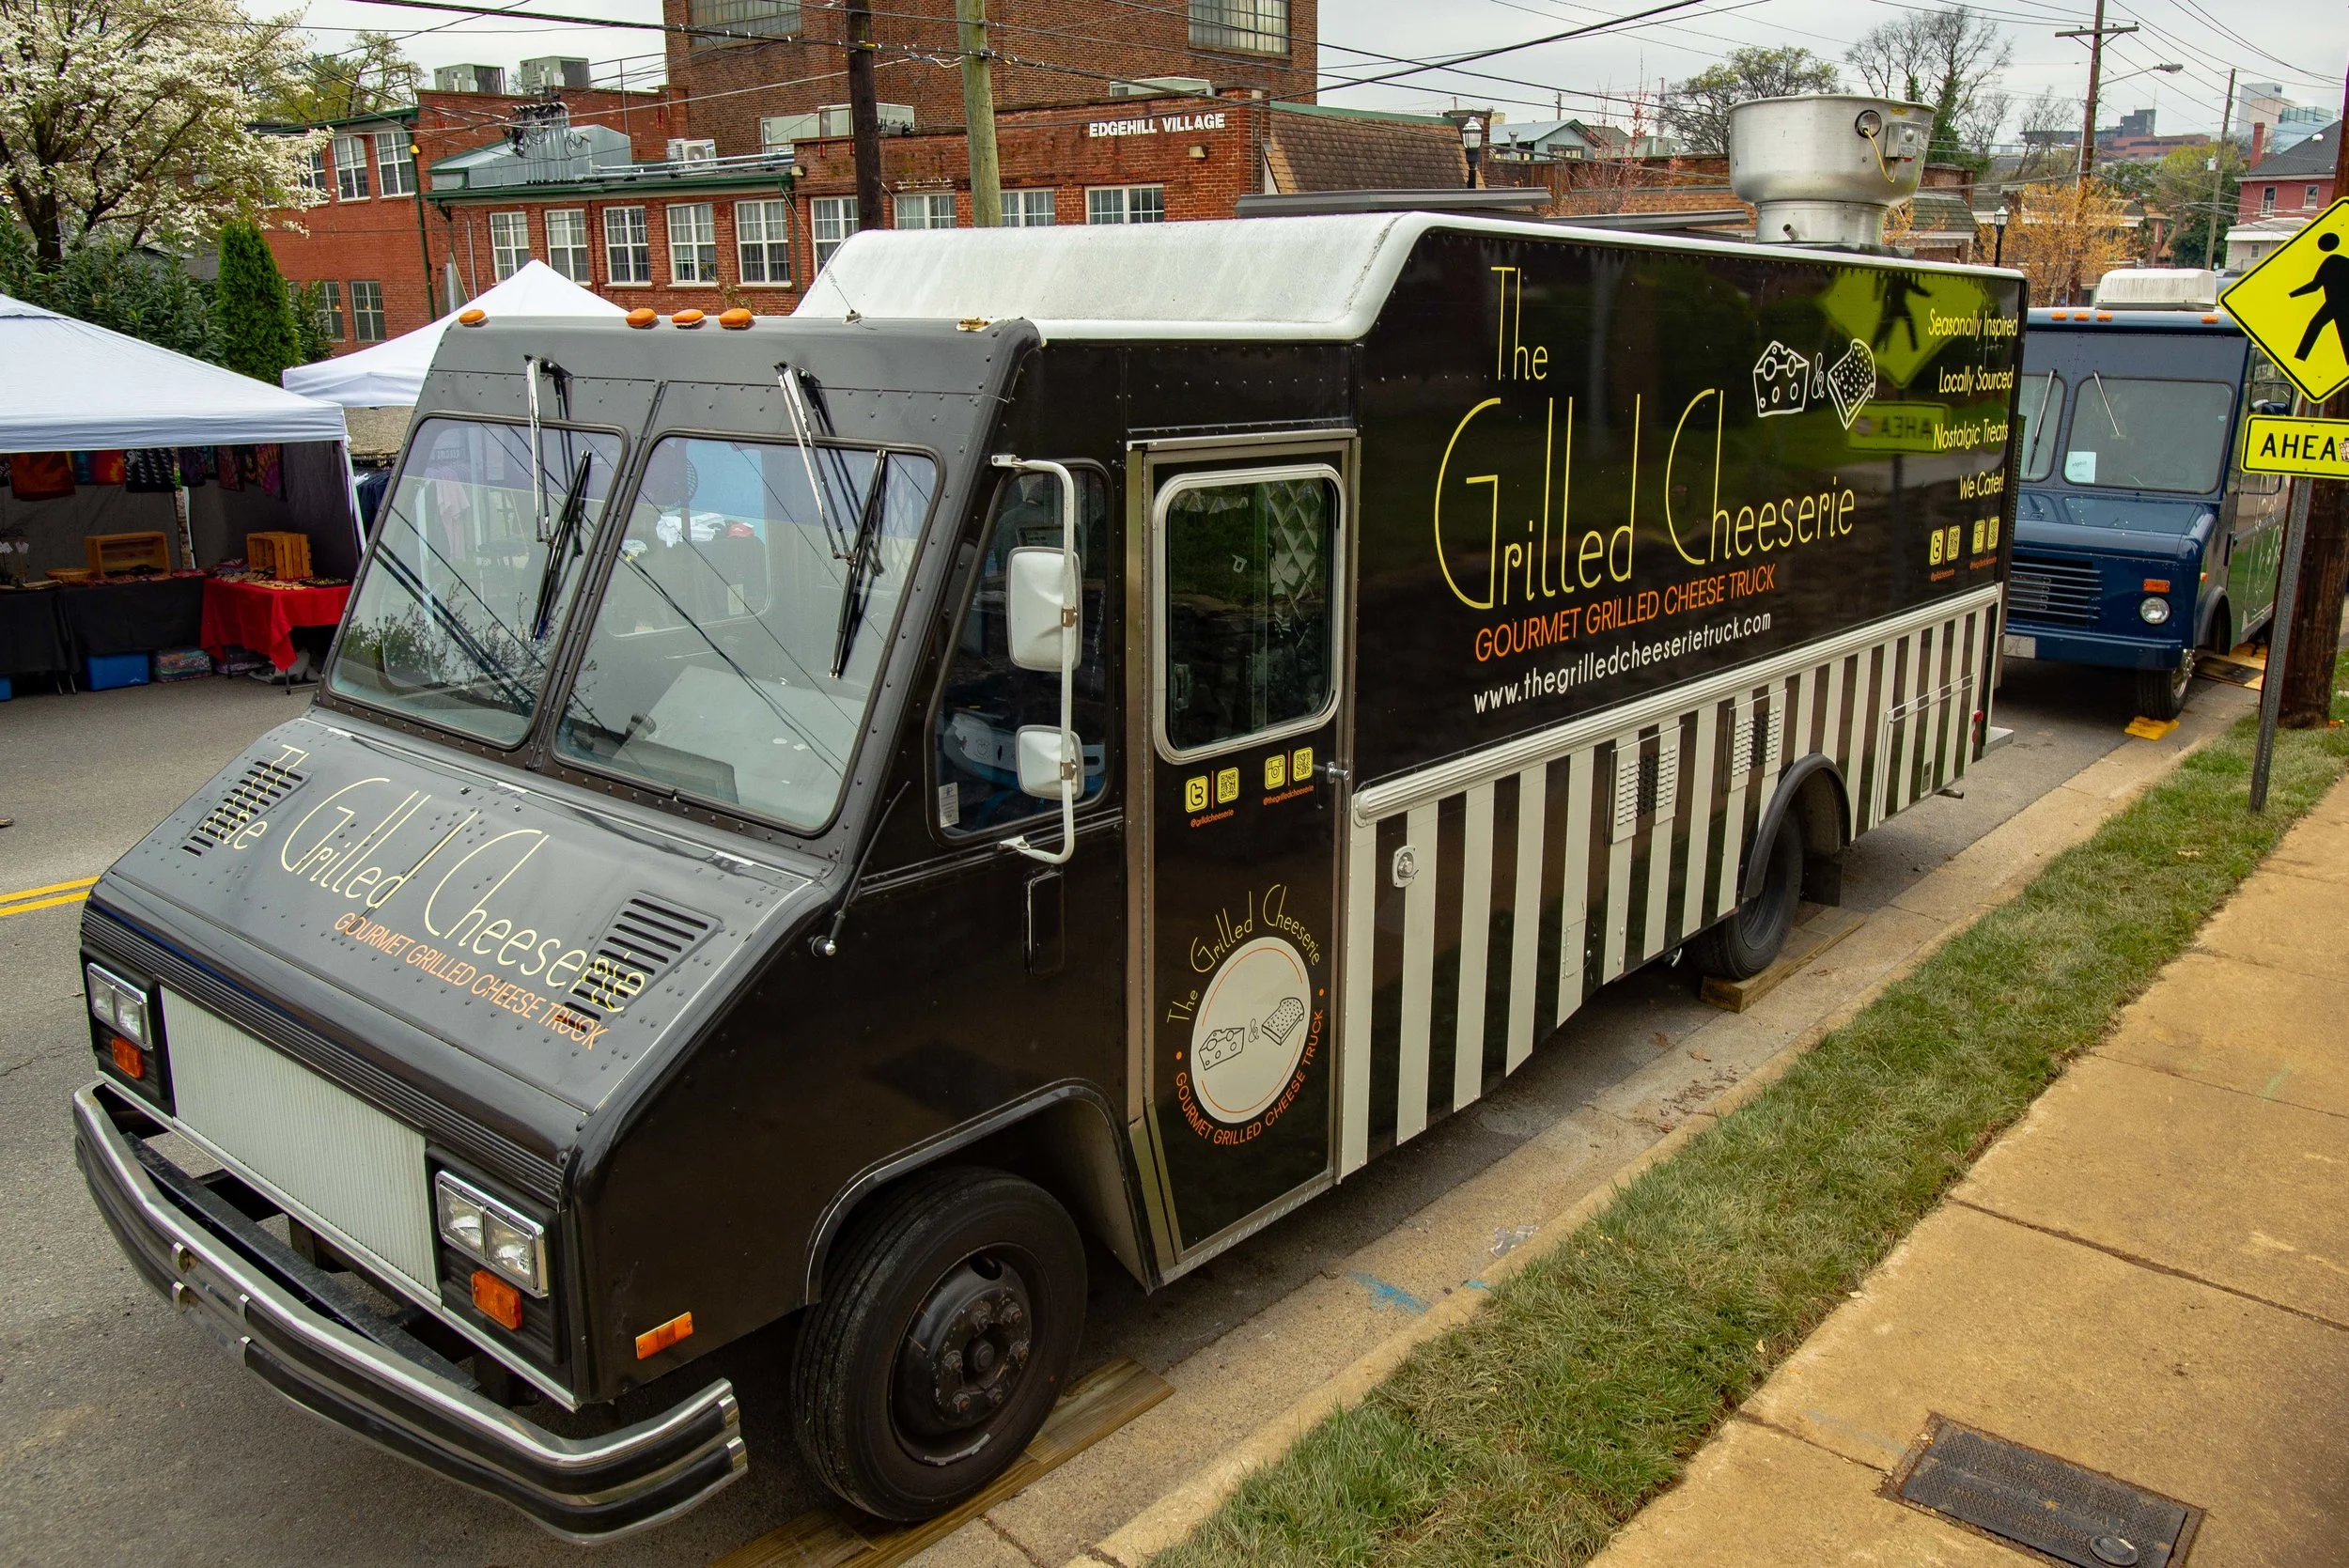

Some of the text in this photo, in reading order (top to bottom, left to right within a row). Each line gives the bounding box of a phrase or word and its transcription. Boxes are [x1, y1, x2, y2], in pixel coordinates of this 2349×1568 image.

[1089, 113, 1225, 138] EDGEHILL VILLAGE
[1490, 266, 1548, 380] The
[1928, 307, 2019, 341] Seasonally Inspired
[1938, 364, 2015, 396] Locally Sourced
[1933, 418, 2008, 450] Nostalgic Treats
[1960, 468, 2005, 500] We Cater!
[2260, 432, 2349, 461] AHEA
[1434, 387, 1856, 611] Grilled Cheeserie
[1475, 563, 1776, 662] GOURMET GRILLED CHEESE TRUCK
[1473, 613, 1772, 714] www.thegrilledcheeserietruck.com
[202, 743, 310, 849] The
[281, 776, 646, 1013] Grilled Cheeserie
[334, 912, 610, 1051] GOURMET GRILLED CHEESE TRUCK
[1166, 883, 1321, 1024] The Grilled Cheeserie
[1175, 1009, 1324, 1146] GOURMET GRILLED CHEESE TRUCK
